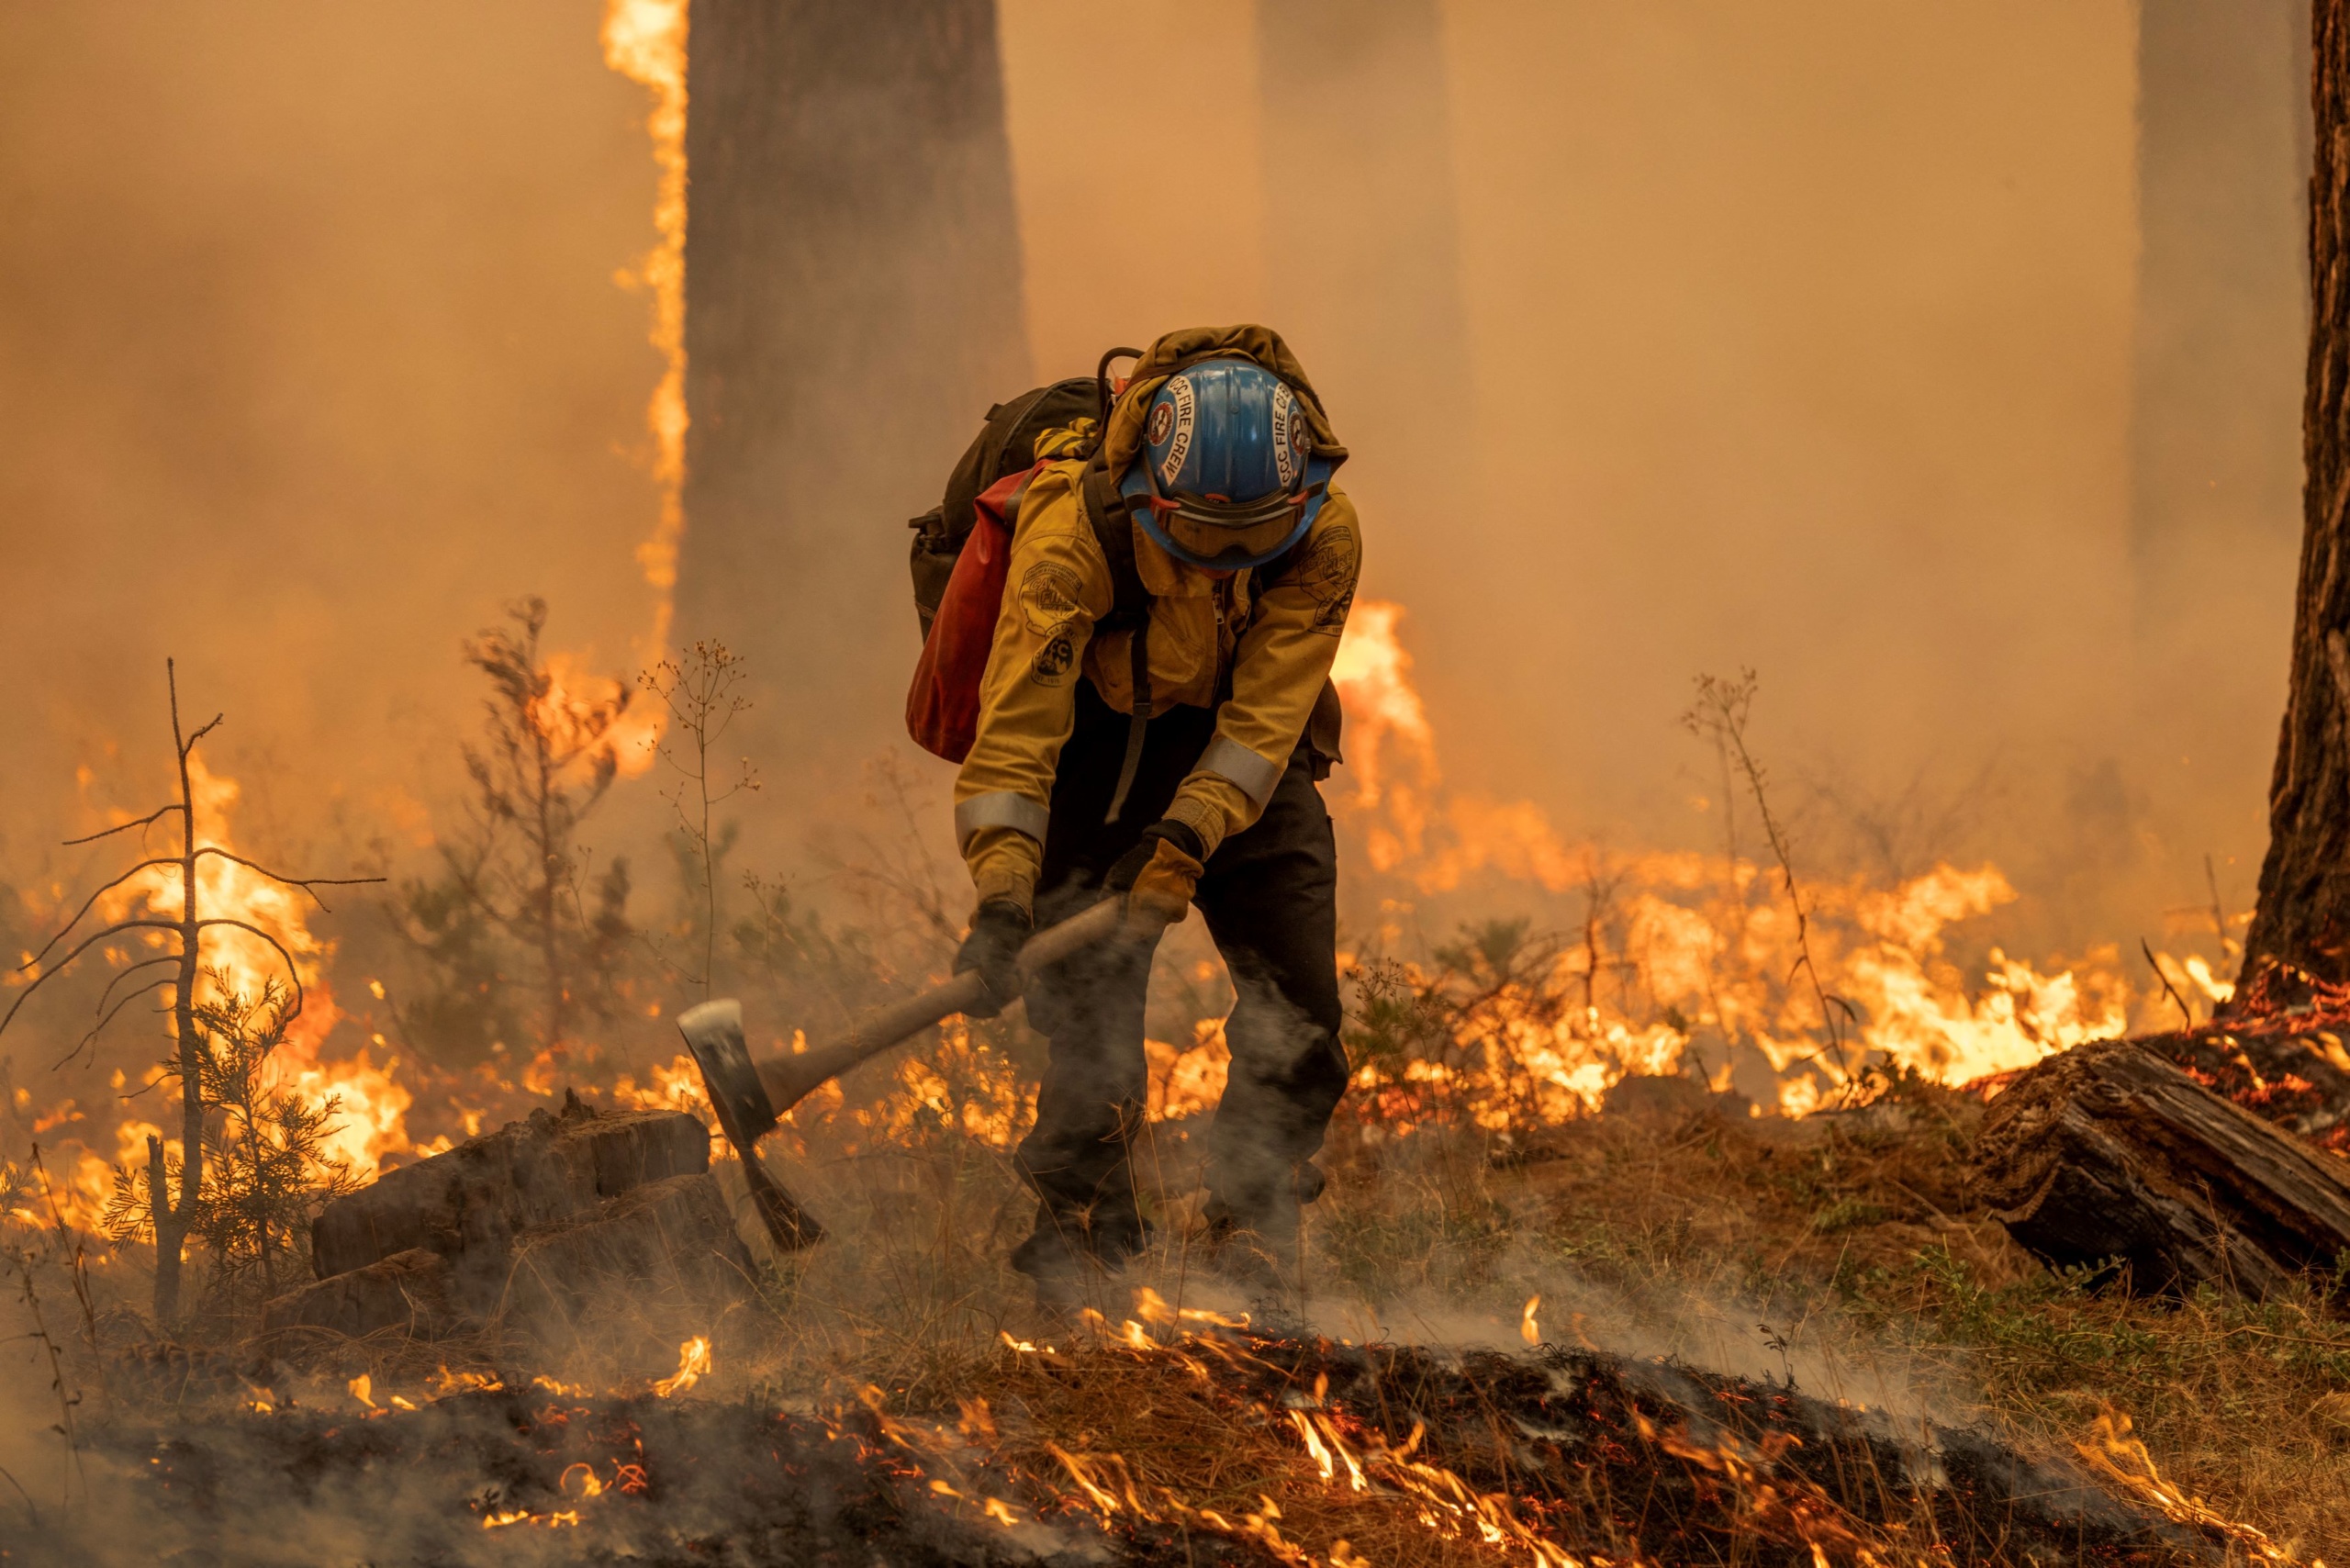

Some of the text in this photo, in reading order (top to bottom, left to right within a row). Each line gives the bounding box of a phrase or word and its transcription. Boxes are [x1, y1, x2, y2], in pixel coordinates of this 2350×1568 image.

[1166, 377, 1192, 477] CCC FIRE CREW
[1274, 410, 1286, 445] FIRE
[1278, 450, 1292, 484] CCC
[1306, 546, 1353, 575] CAL FIRE
